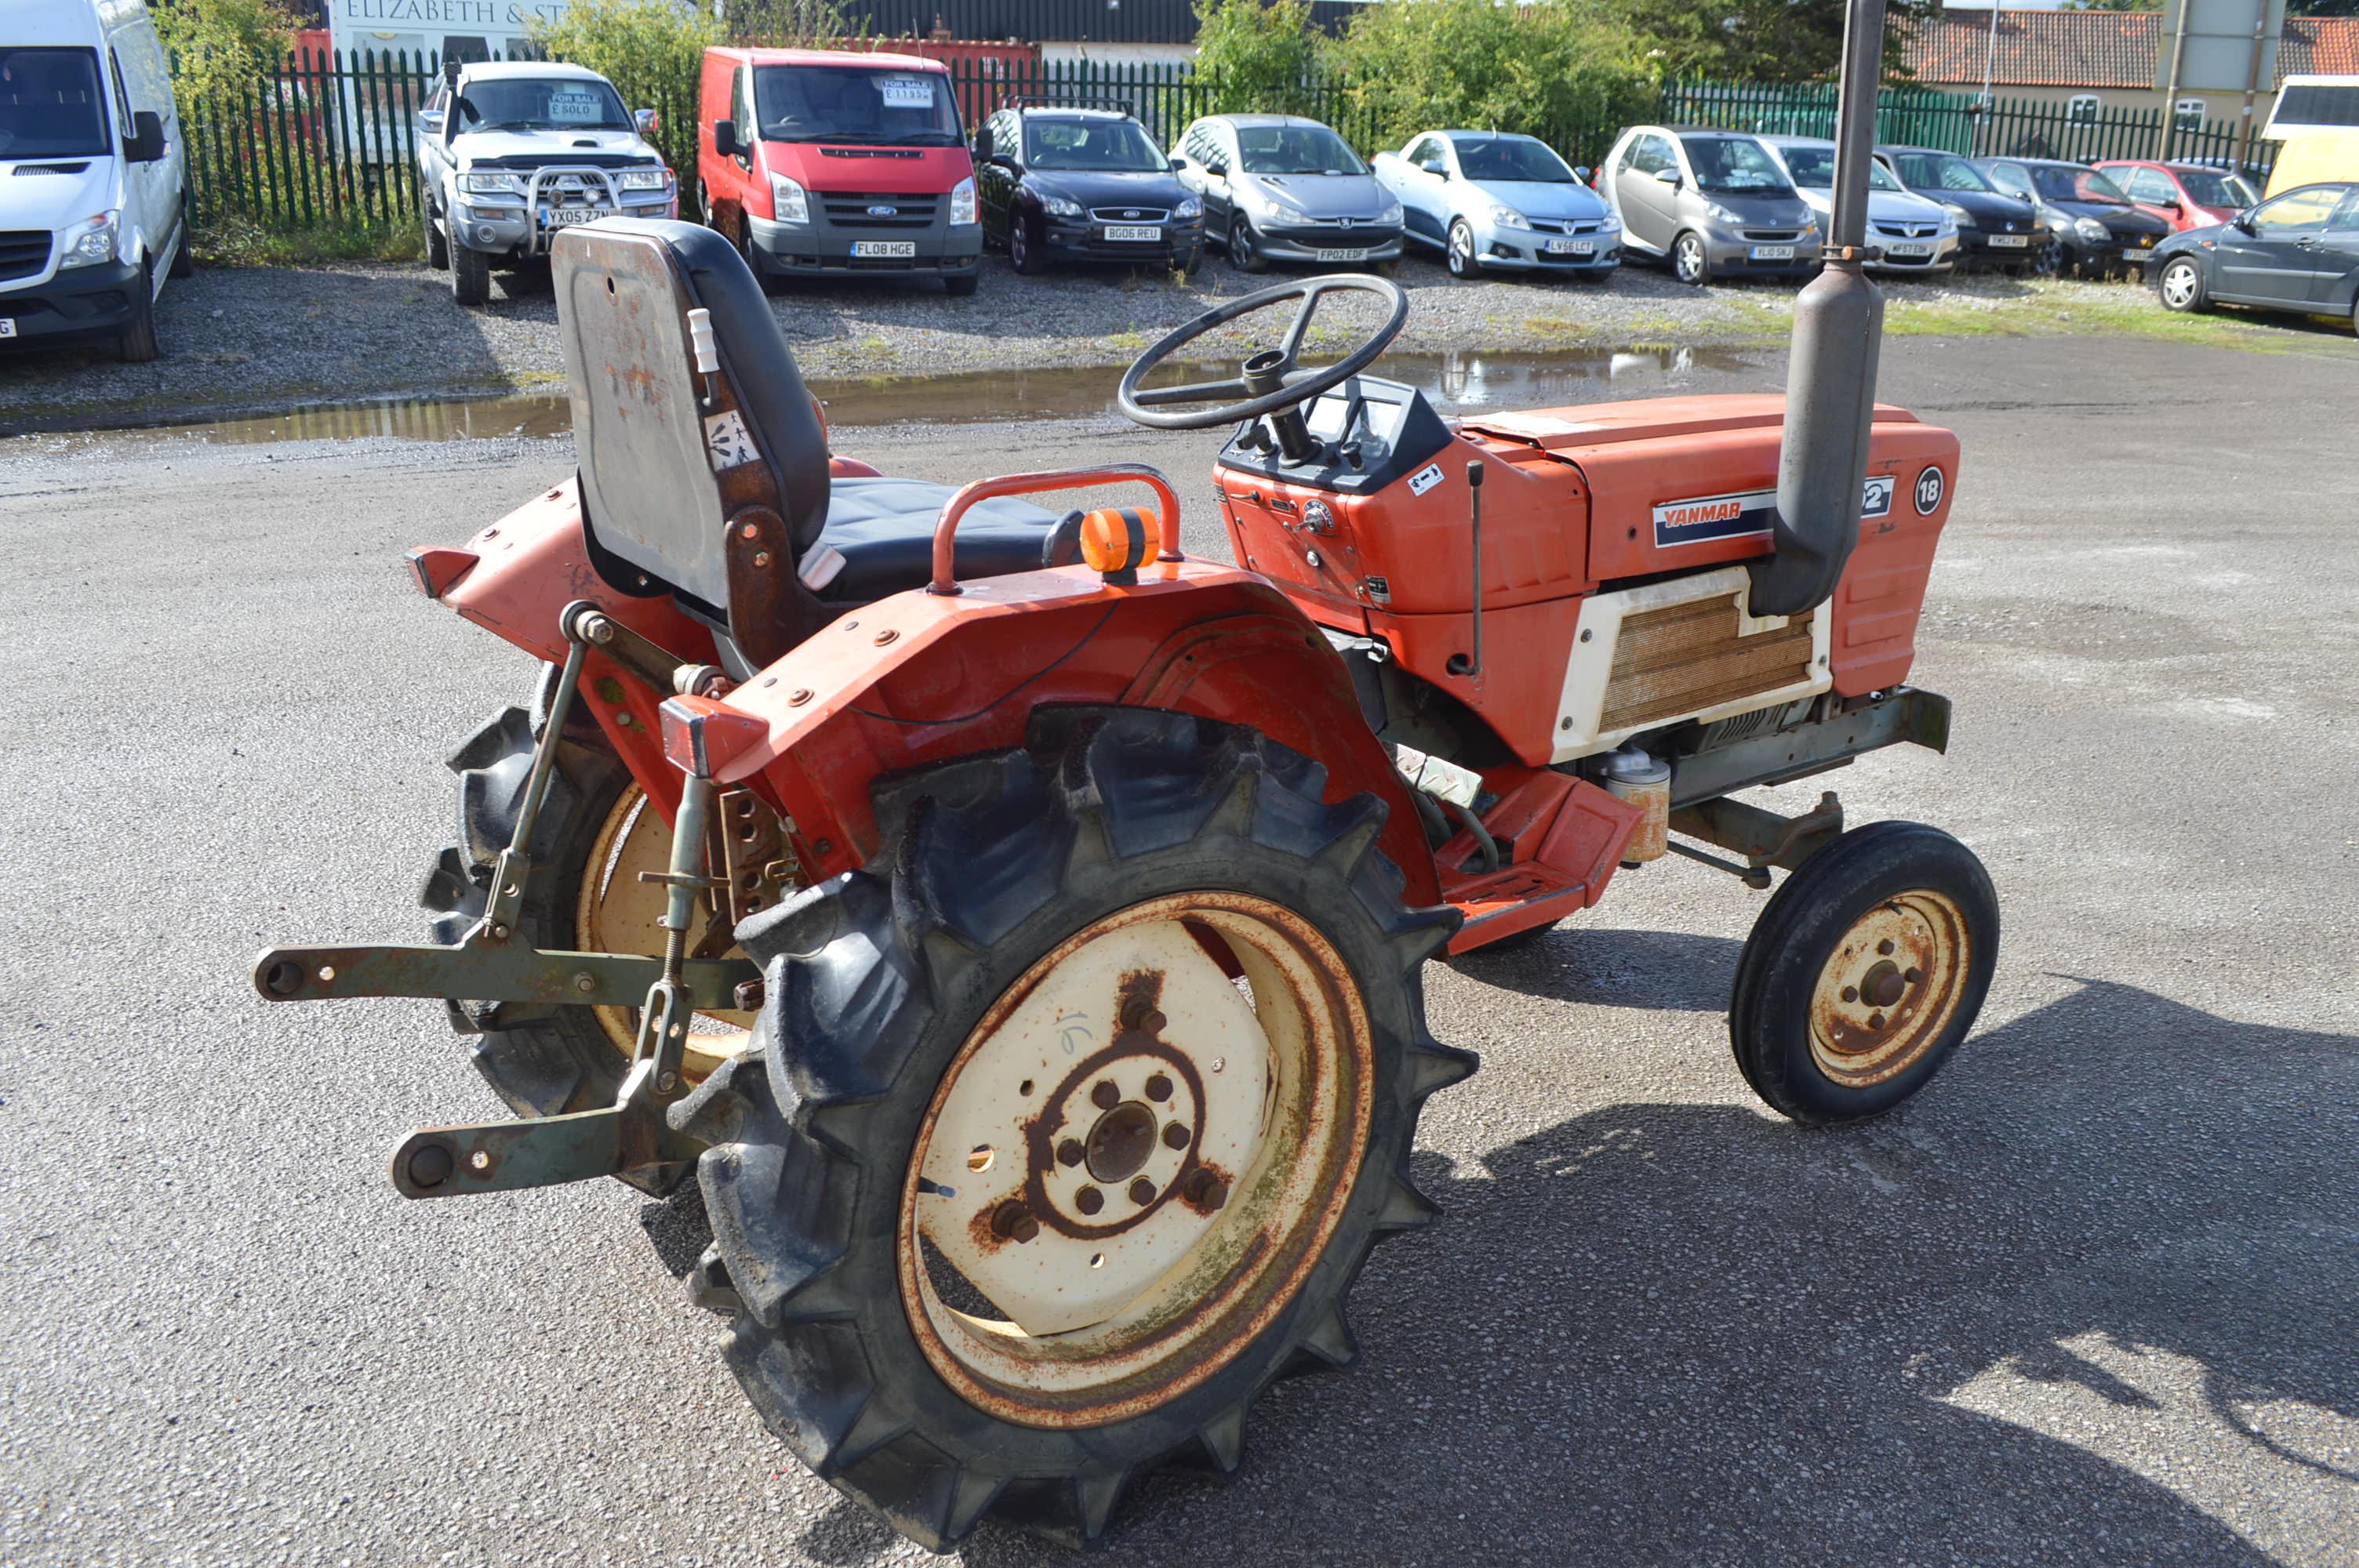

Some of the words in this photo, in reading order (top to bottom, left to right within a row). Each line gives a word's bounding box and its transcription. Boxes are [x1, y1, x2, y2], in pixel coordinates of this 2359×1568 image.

[347, 0, 496, 23] ELIZABETH
[506, 3, 525, 24] &
[574, 94, 598, 103] SALE
[562, 105, 590, 114] SOLD
[550, 211, 582, 222] YX05
[1109, 228, 1135, 238] BG06
[1137, 229, 1158, 238] REU
[858, 244, 888, 255] FL08
[891, 244, 912, 255] HGE
[1576, 242, 1590, 252] LCT
[1321, 250, 1345, 260] FP02
[1346, 249, 1365, 259] EDF
[1919, 479, 1939, 503] 18
[1663, 501, 1742, 528] YANMAR
